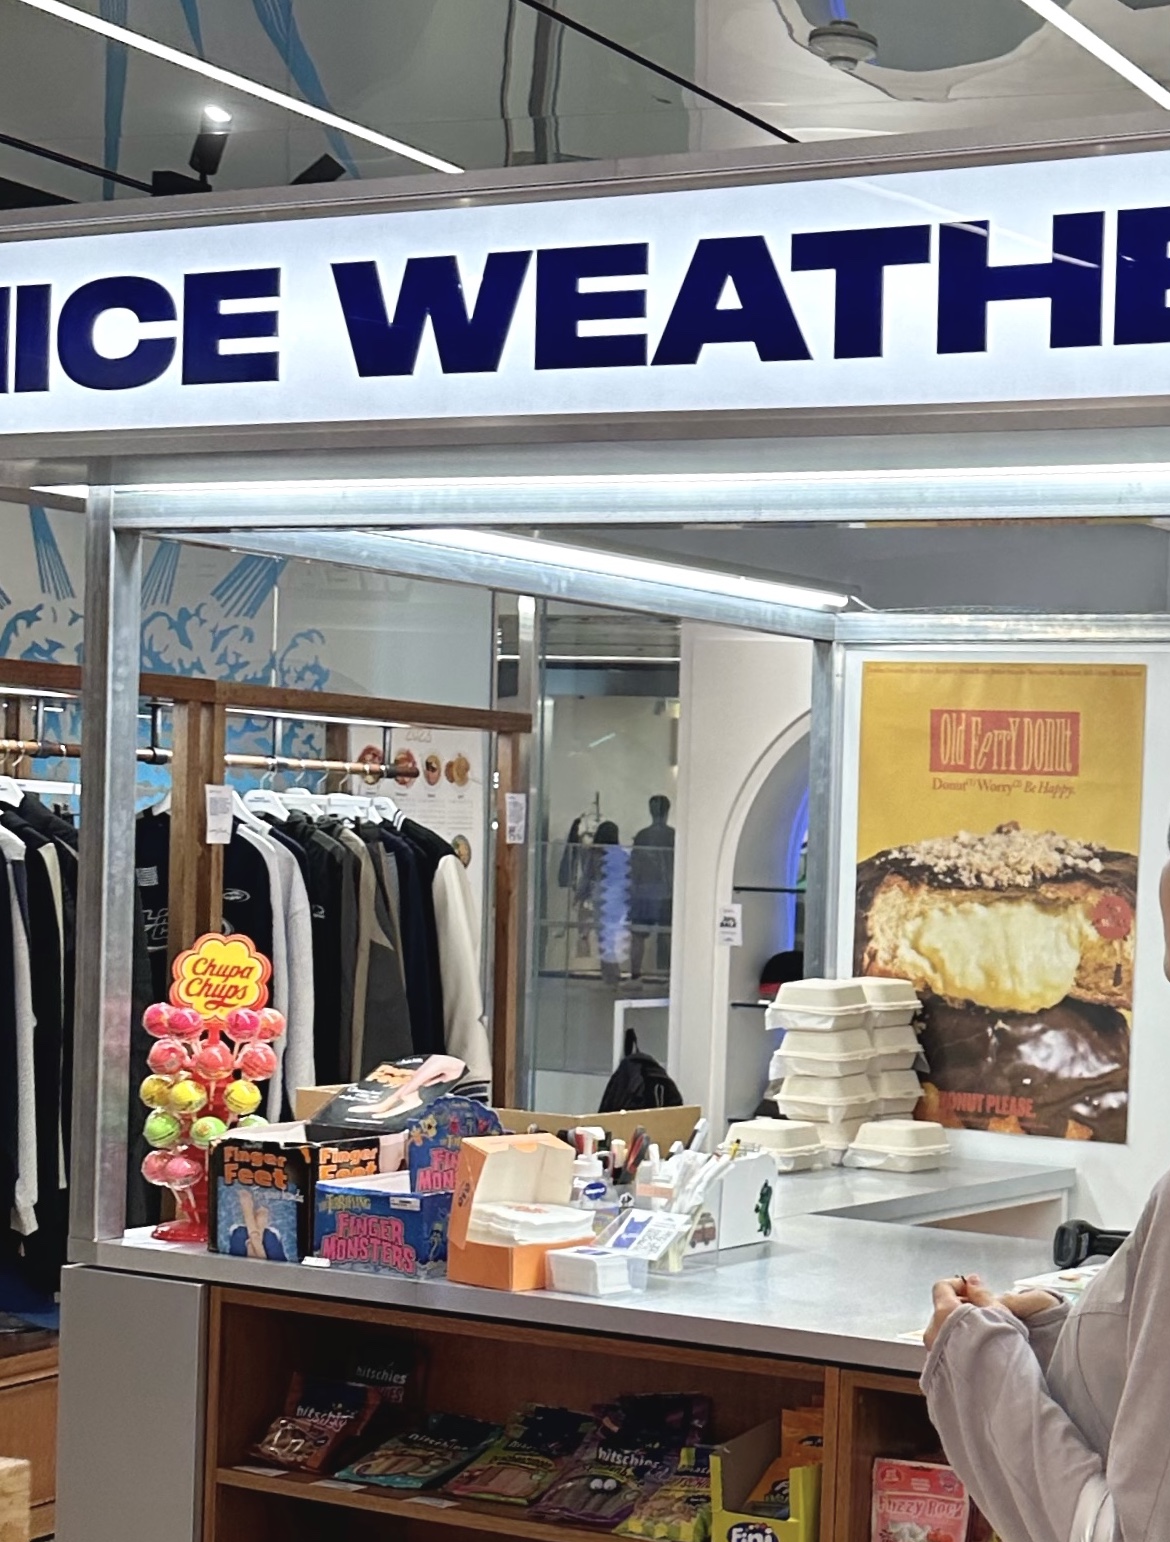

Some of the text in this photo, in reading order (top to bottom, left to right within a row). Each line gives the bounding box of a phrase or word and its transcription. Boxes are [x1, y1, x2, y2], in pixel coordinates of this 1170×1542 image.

[191, 956, 255, 986] Chupa
[185, 978, 250, 1004] Chups
[223, 1145, 288, 1169] Finger
[319, 1146, 379, 1166] Finger
[223, 1163, 289, 1191] Feet
[336, 1212, 405, 1244] FINGER
[321, 1235, 418, 1275] MONSTERS
